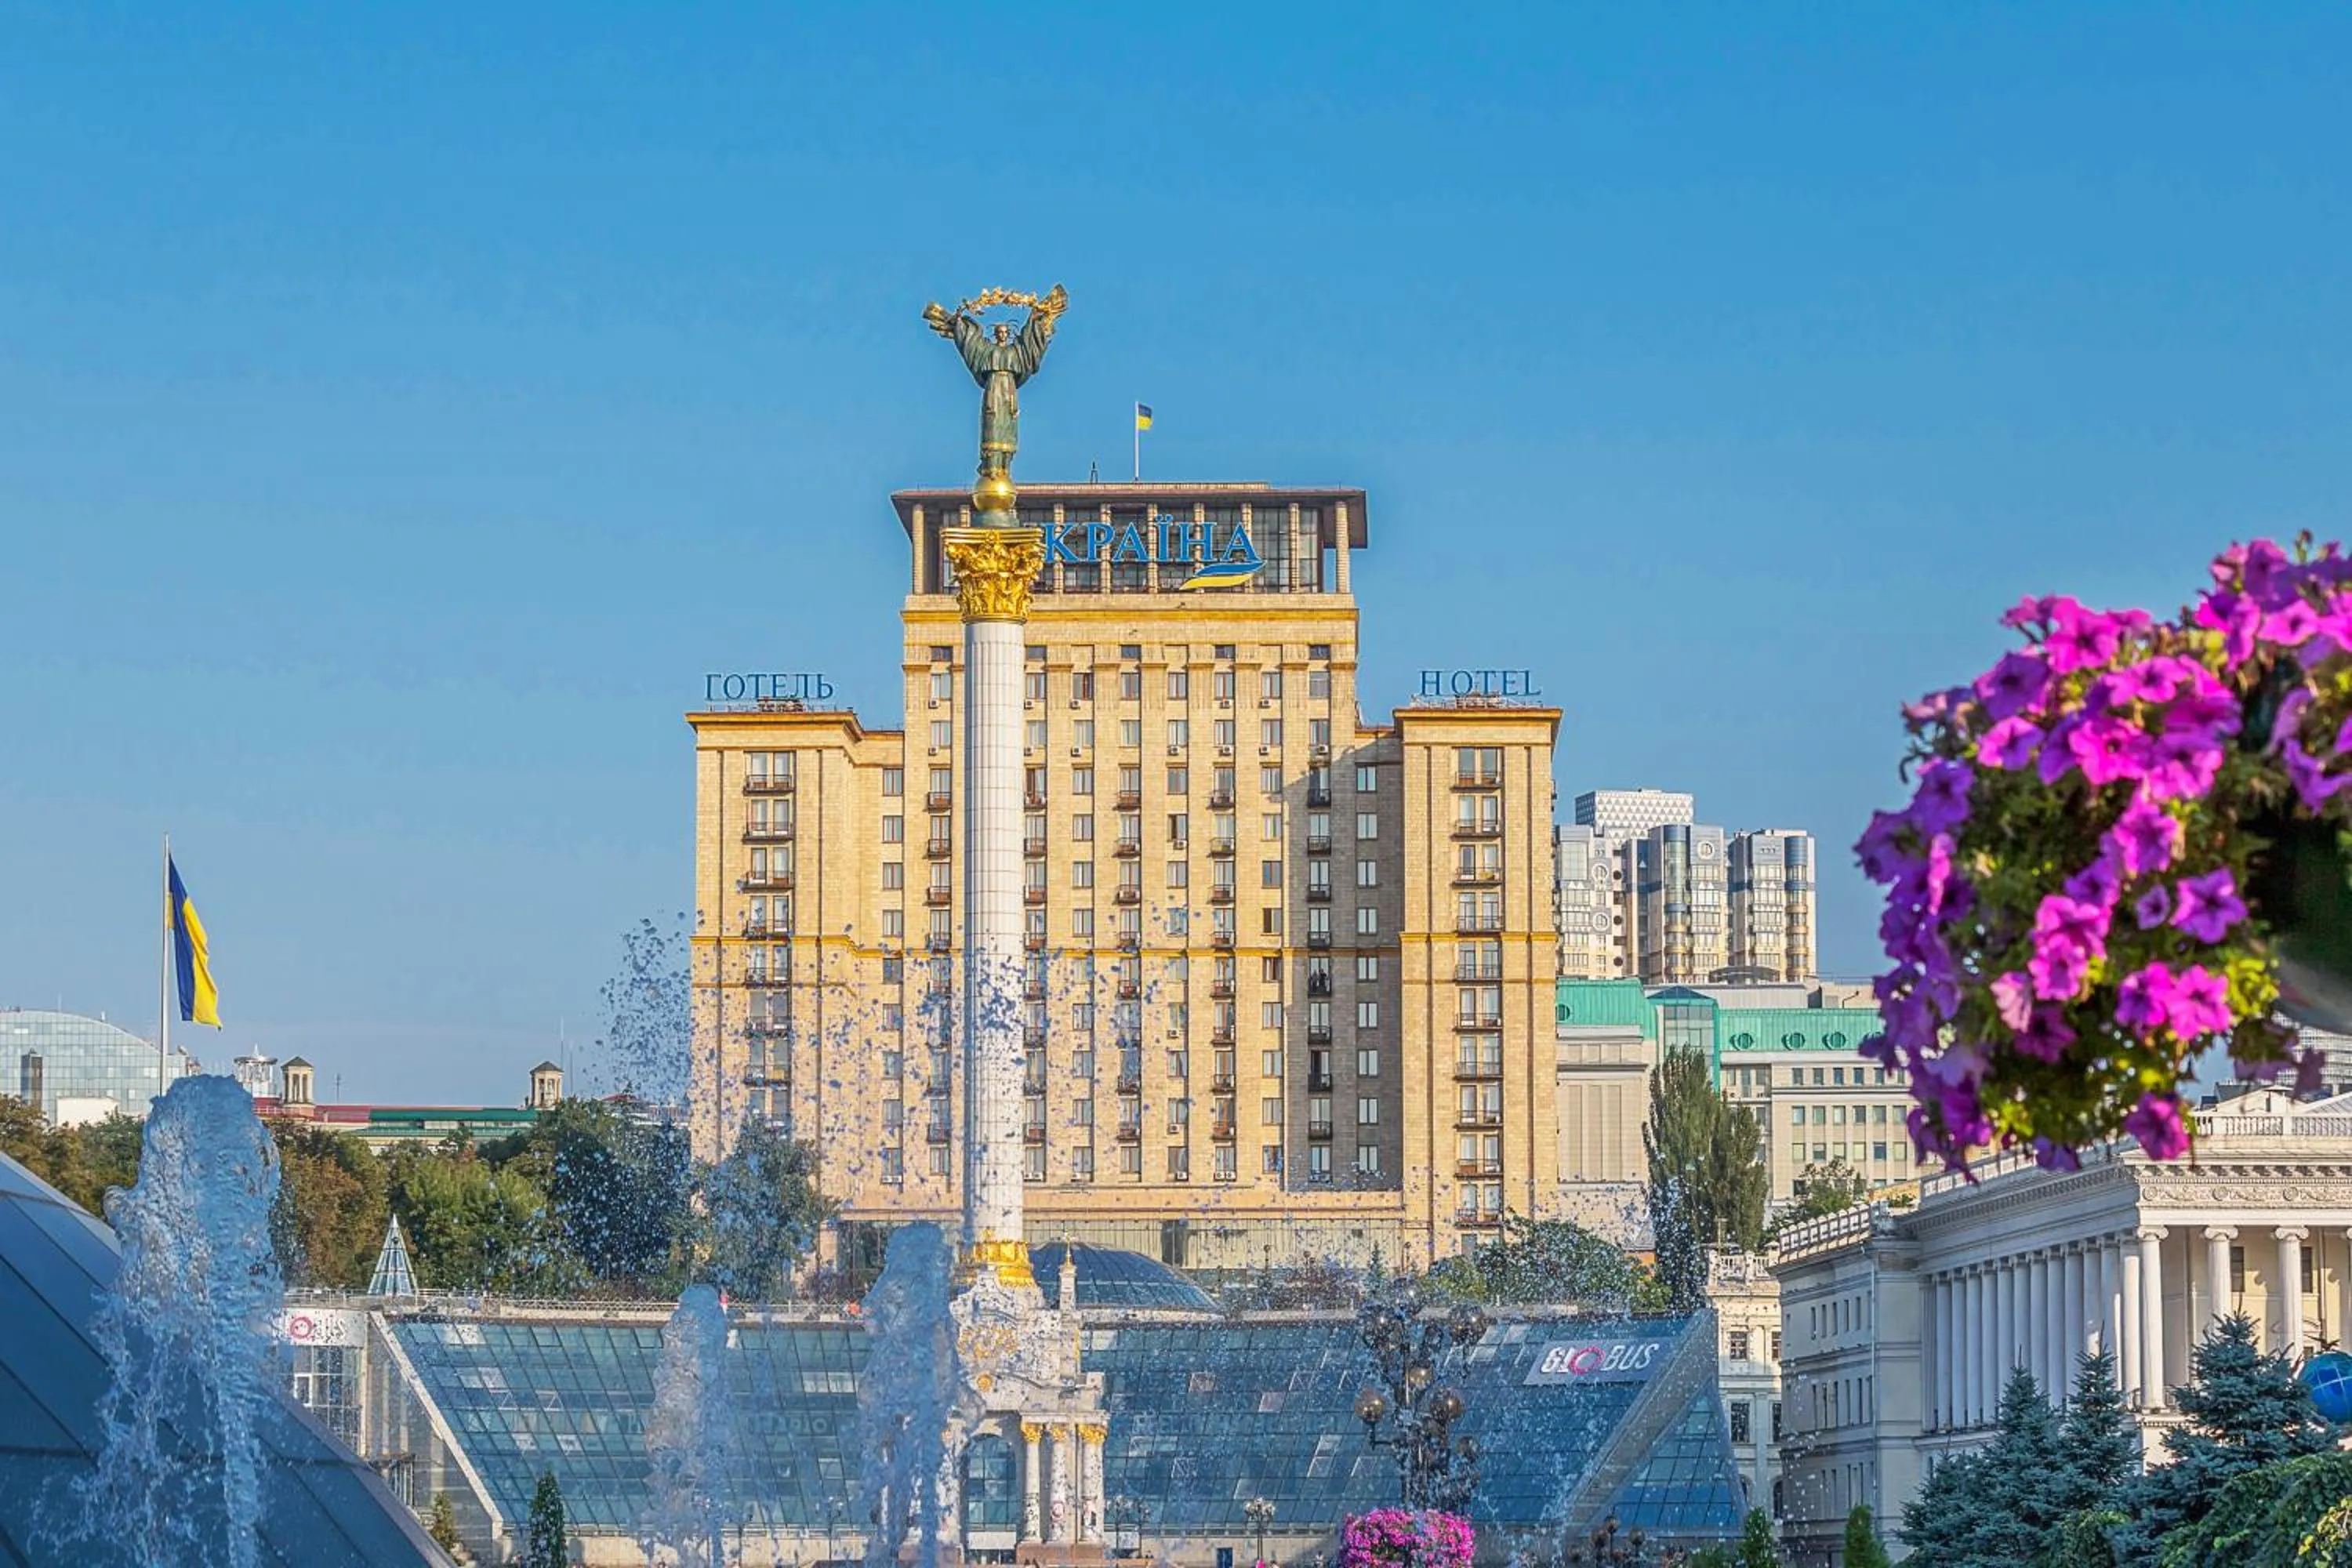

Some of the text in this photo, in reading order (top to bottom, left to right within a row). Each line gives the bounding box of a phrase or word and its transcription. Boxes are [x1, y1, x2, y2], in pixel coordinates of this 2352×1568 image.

[1024, 514, 1261, 563] КРАЇНА
[706, 673, 834, 700] ГОТЕЛЬ
[1420, 670, 1542, 696] HOTEL
[1541, 1343, 1660, 1374] GLOBUS
